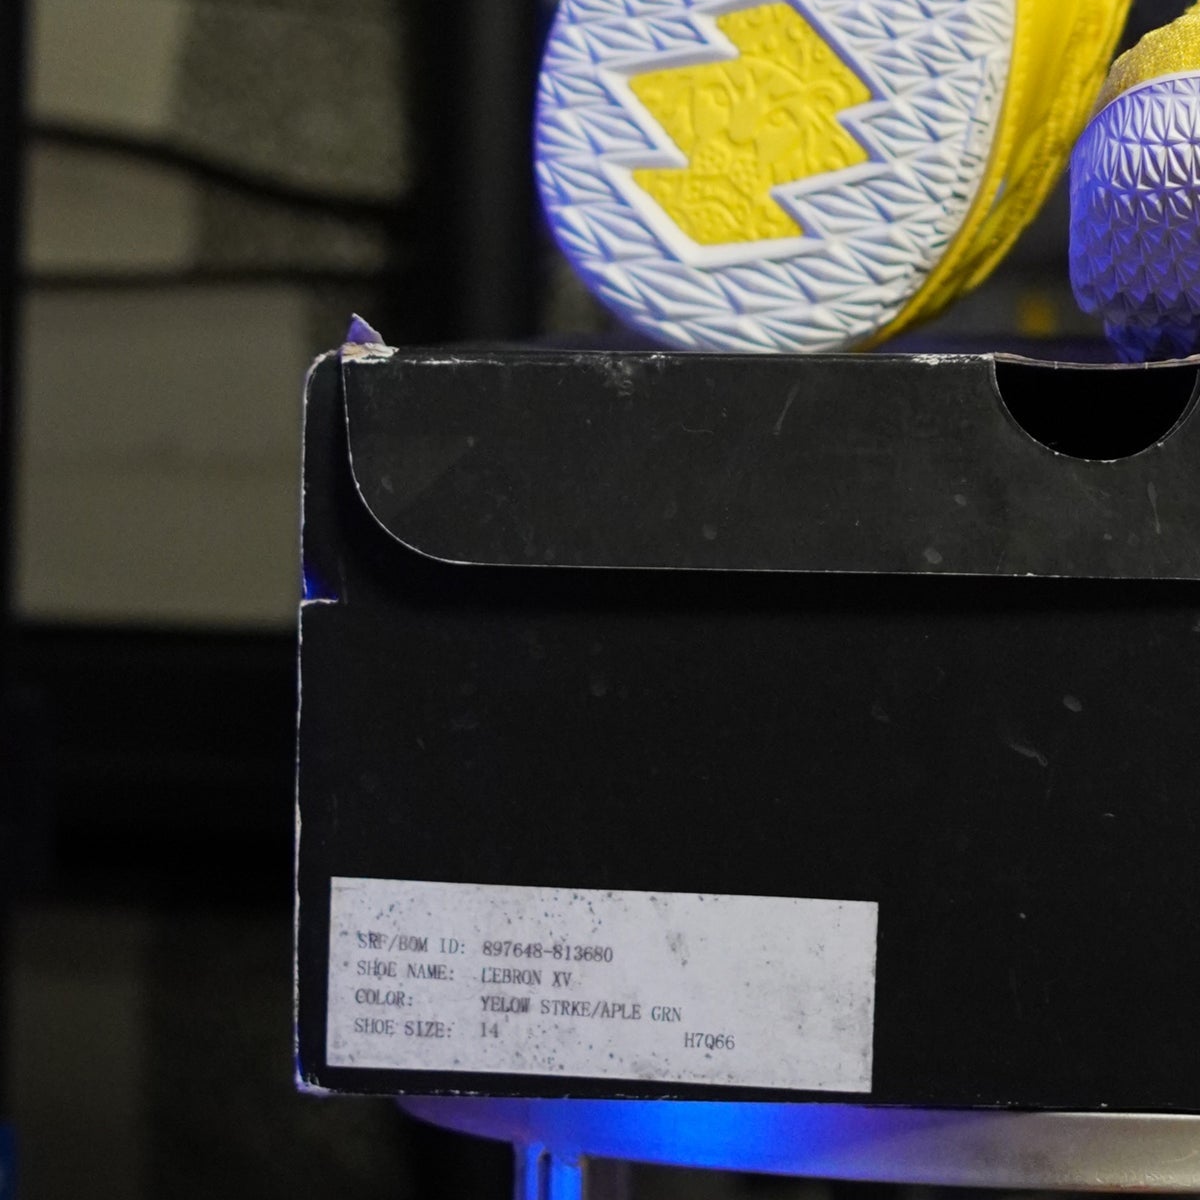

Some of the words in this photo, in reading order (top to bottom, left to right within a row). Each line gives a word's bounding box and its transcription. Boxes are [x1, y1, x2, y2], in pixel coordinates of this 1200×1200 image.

[440, 938, 465, 954] ID:
[482, 940, 614, 963] 897648-813680
[356, 959, 397, 978] SHOE
[407, 963, 454, 981] NAME:
[481, 966, 542, 985] LEBRON
[552, 971, 572, 987] XV
[355, 988, 413, 1007] COLOR:
[480, 995, 531, 1013] YELOW
[540, 999, 641, 1020] STRKE/APLE
[651, 1005, 683, 1022] GRN
[354, 1017, 395, 1036] SHOE
[404, 1020, 452, 1038] SIZE:
[480, 1021, 499, 1038] 14
[684, 1031, 736, 1050] H7Q66
